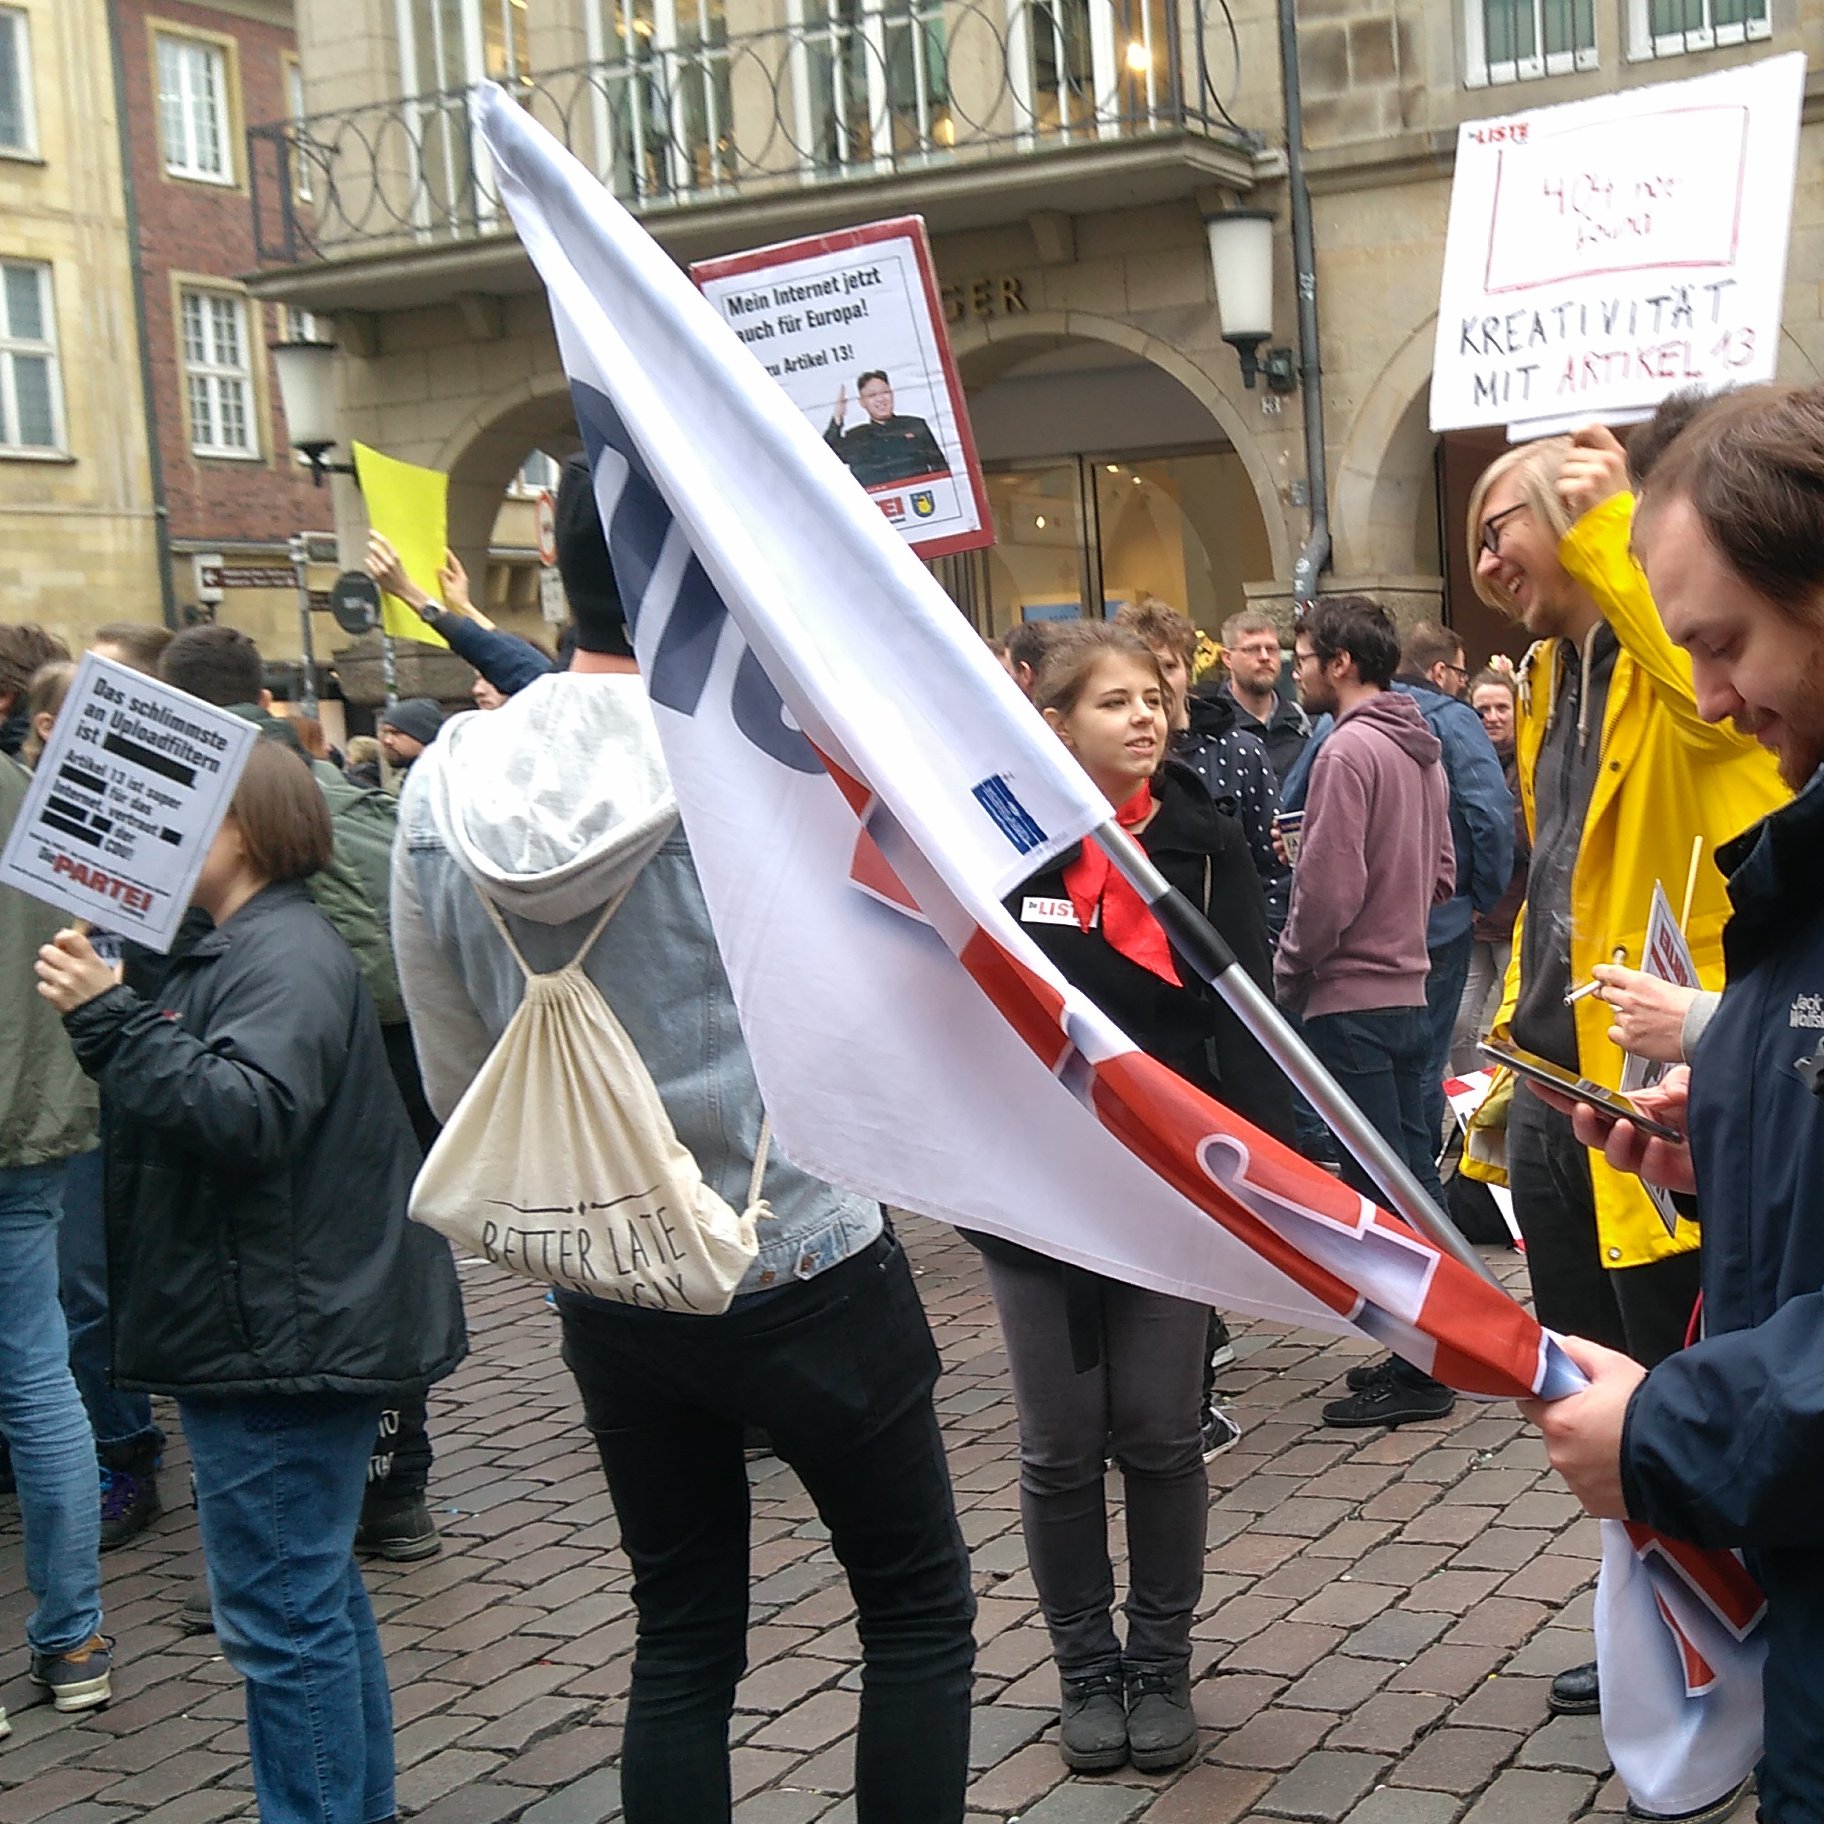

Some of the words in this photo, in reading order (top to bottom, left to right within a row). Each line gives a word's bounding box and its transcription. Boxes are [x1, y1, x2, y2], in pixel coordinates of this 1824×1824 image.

[726, 293, 770, 317] Mein
[773, 276, 840, 306] Internet
[843, 266, 882, 295] jetzt
[1459, 278, 1738, 356] KREATIVITÄT
[736, 321, 775, 345] auch
[777, 315, 802, 335] für
[805, 298, 869, 329] Europa!
[784, 350, 829, 374] Artikel
[831, 344, 855, 363] 13!
[1473, 364, 1541, 407] MIT
[1556, 340, 1704, 395] ARTIKEL
[1710, 327, 1756, 369] 13
[75, 720, 101, 745] ist
[84, 702, 106, 722] an
[110, 710, 221, 774] Uploadfiltern
[93, 677, 126, 705] Das
[129, 697, 228, 751] schlimmste
[65, 749, 107, 777] Artikel
[110, 768, 126, 785] 13
[127, 776, 145, 793] ist
[146, 788, 182, 810] super
[109, 786, 128, 803] für
[130, 797, 152, 816] das
[53, 853, 155, 912] PARTEI
[1791, 993, 1823, 1011] Jack
[482, 1220, 597, 1281] BETTER
[608, 1206, 687, 1276] LATE
